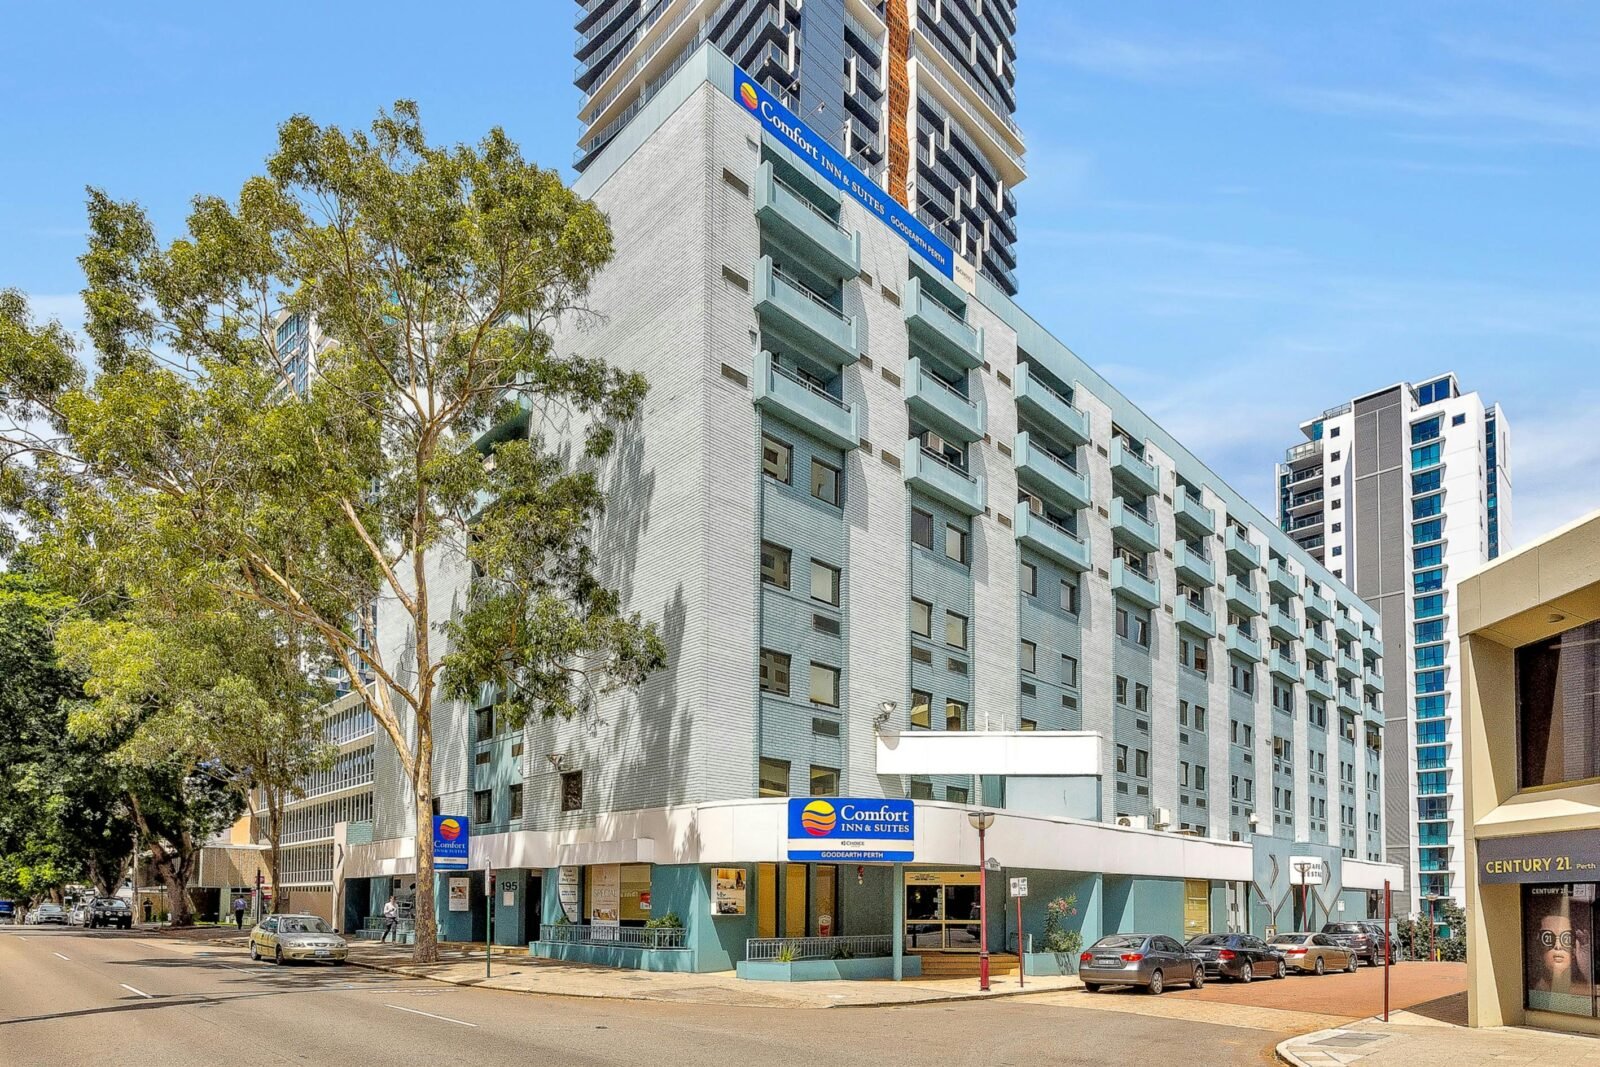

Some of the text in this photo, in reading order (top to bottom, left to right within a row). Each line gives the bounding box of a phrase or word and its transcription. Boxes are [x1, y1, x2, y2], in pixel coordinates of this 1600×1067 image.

[761, 101, 945, 265] Comfort INN & SUITES GOODEARTH PERTH
[840, 804, 909, 822] Comfort
[841, 824, 910, 833] INN & SUITES
[434, 840, 465, 849] Comfort
[1485, 857, 1552, 874] CENTURY
[501, 881, 518, 891] 195
